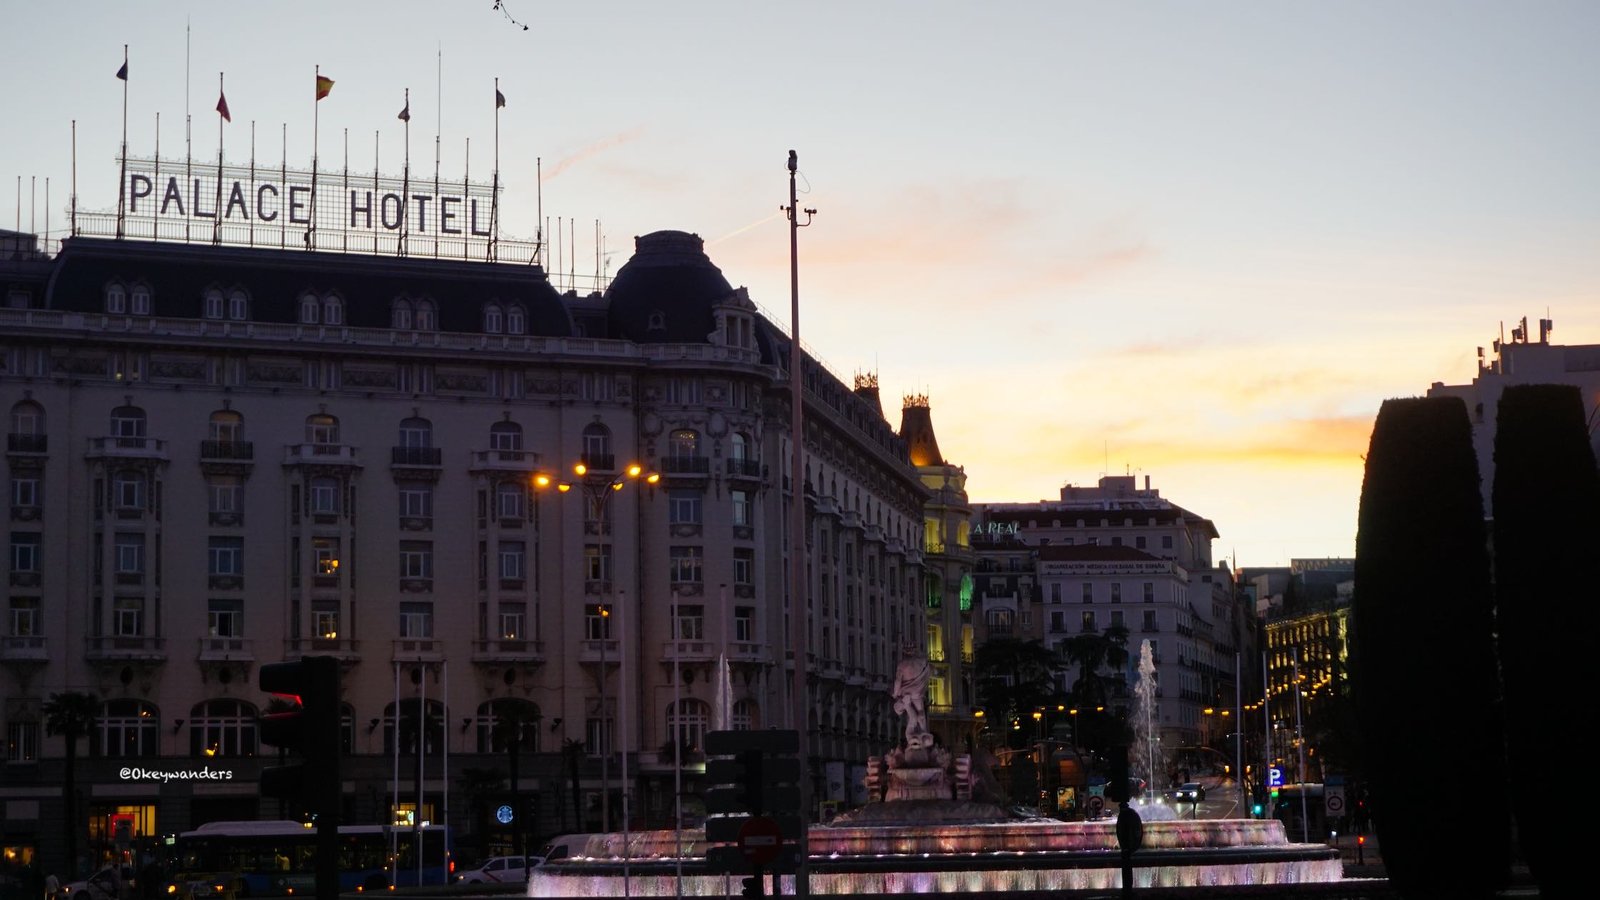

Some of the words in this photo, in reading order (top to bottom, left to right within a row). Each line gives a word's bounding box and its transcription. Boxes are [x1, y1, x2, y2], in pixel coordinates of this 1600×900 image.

[130, 174, 311, 224] PALACE
[351, 191, 491, 237] HOTEL
[1269, 768, 1281, 785] P
